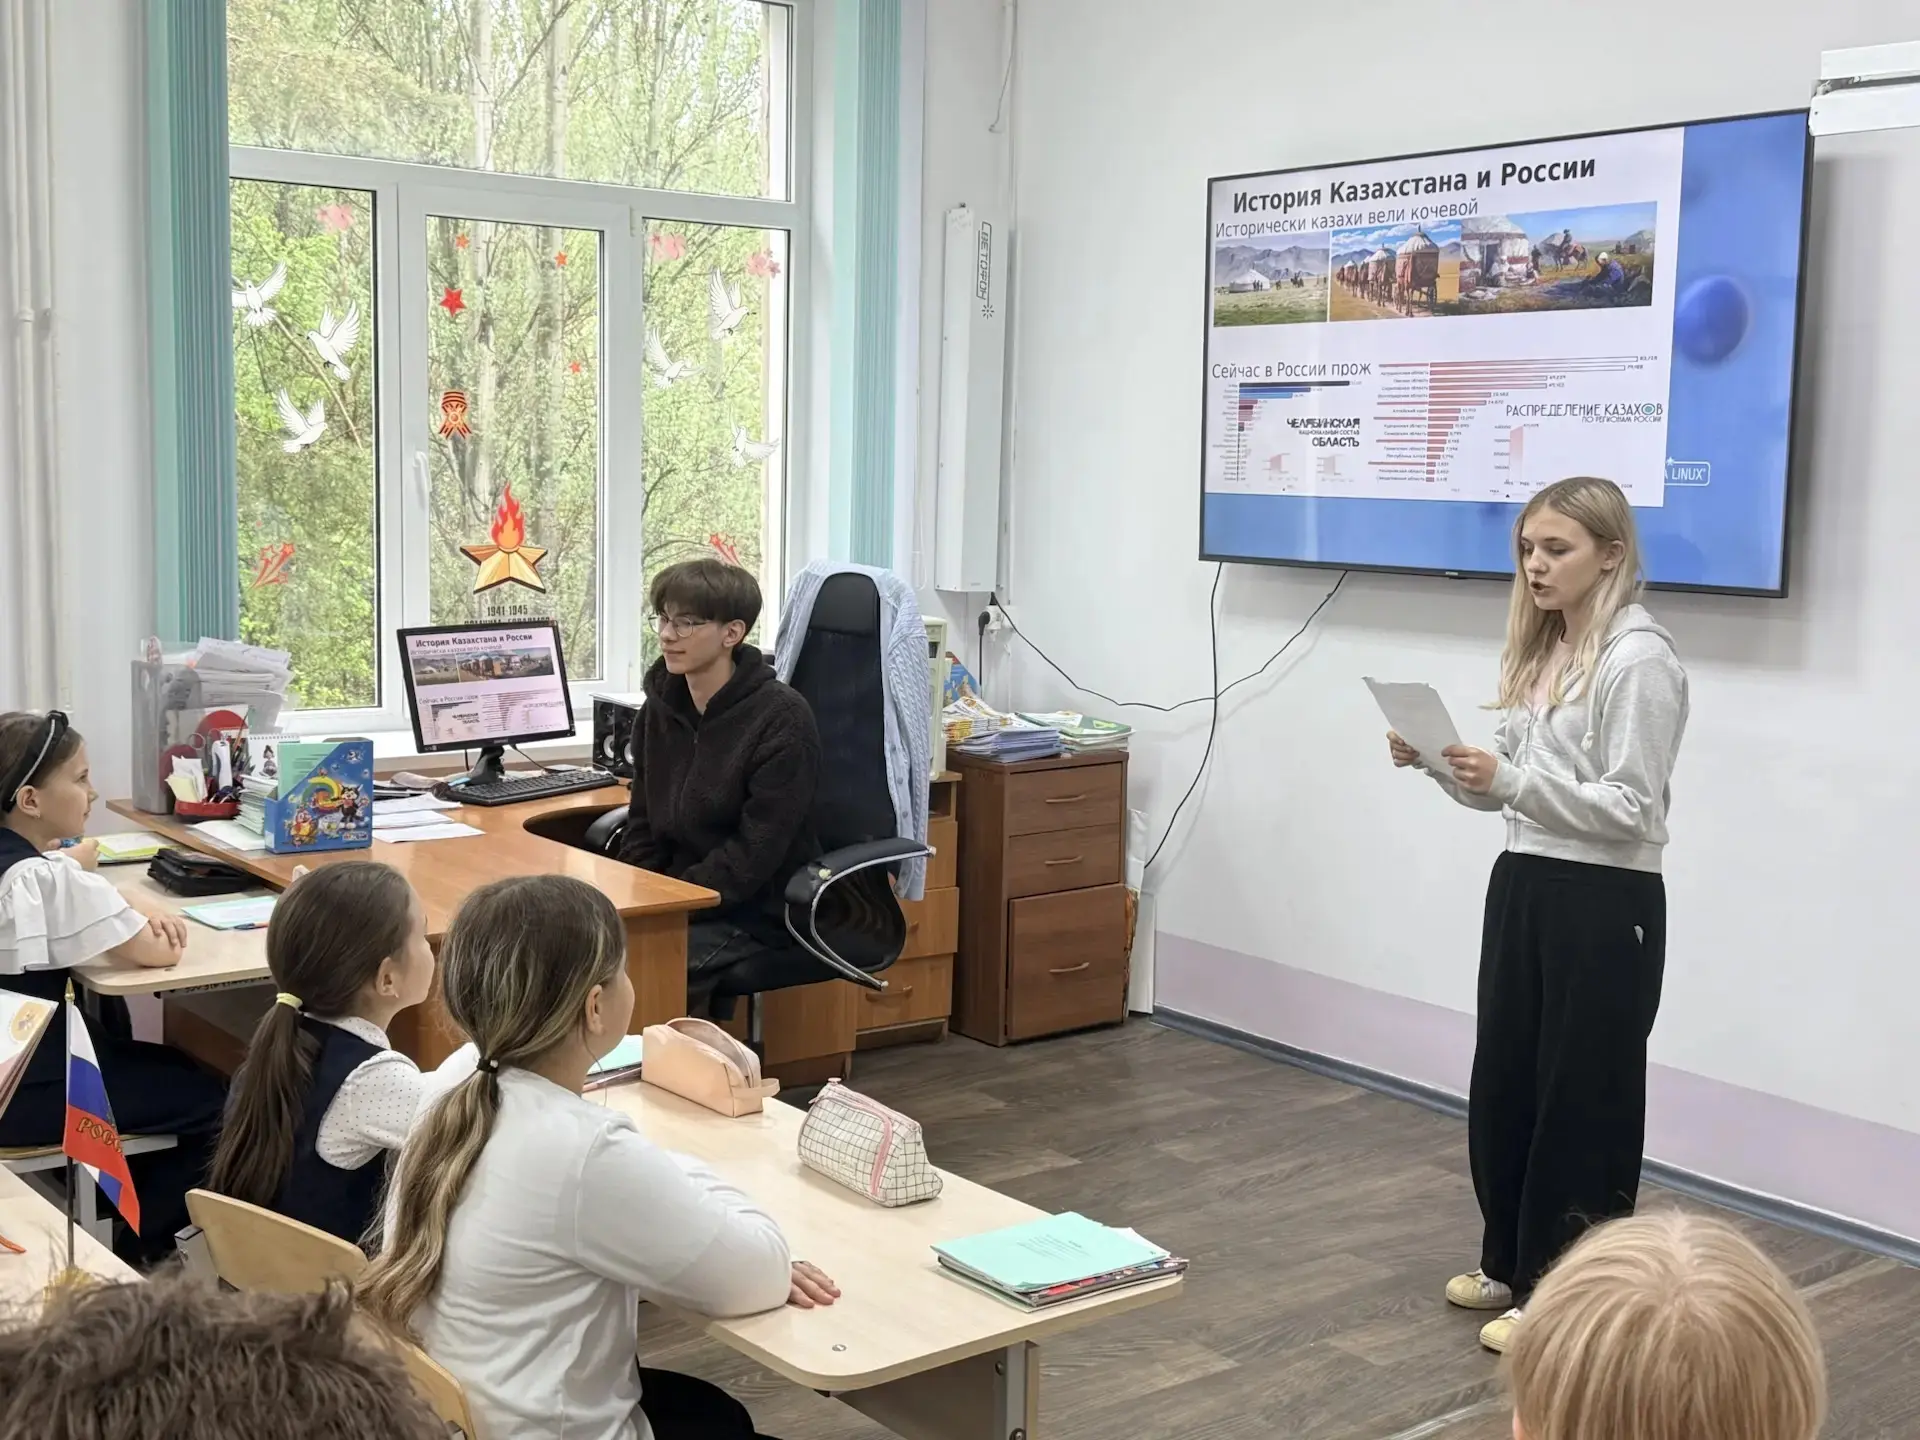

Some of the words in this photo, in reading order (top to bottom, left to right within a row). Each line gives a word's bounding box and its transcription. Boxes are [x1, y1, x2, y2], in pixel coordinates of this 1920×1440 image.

[1232, 188, 1322, 215] История
[1329, 172, 1468, 204] Казахстана
[1476, 170, 1491, 188] и
[1500, 157, 1597, 187] России
[1215, 217, 1307, 239] Исторически
[1311, 213, 1362, 230] казахи
[1368, 208, 1405, 225] вели
[1411, 197, 1479, 221] кочевой
[1212, 363, 1261, 379] Сейчас
[1265, 365, 1273, 377] в
[1277, 361, 1327, 377] России
[1331, 362, 1372, 378] прож
[1506, 403, 1601, 417] РАСПРЕДЕЛЕНИЕ
[1604, 403, 1663, 416] КАЗАХОВ
[1286, 417, 1361, 429] ЧЕЛЯБИНСКАЯ
[1312, 436, 1361, 448] ОБЛАСТЬ
[415, 639, 450, 648] История
[452, 636, 498, 645] Казахстана
[506, 634, 533, 642] России
